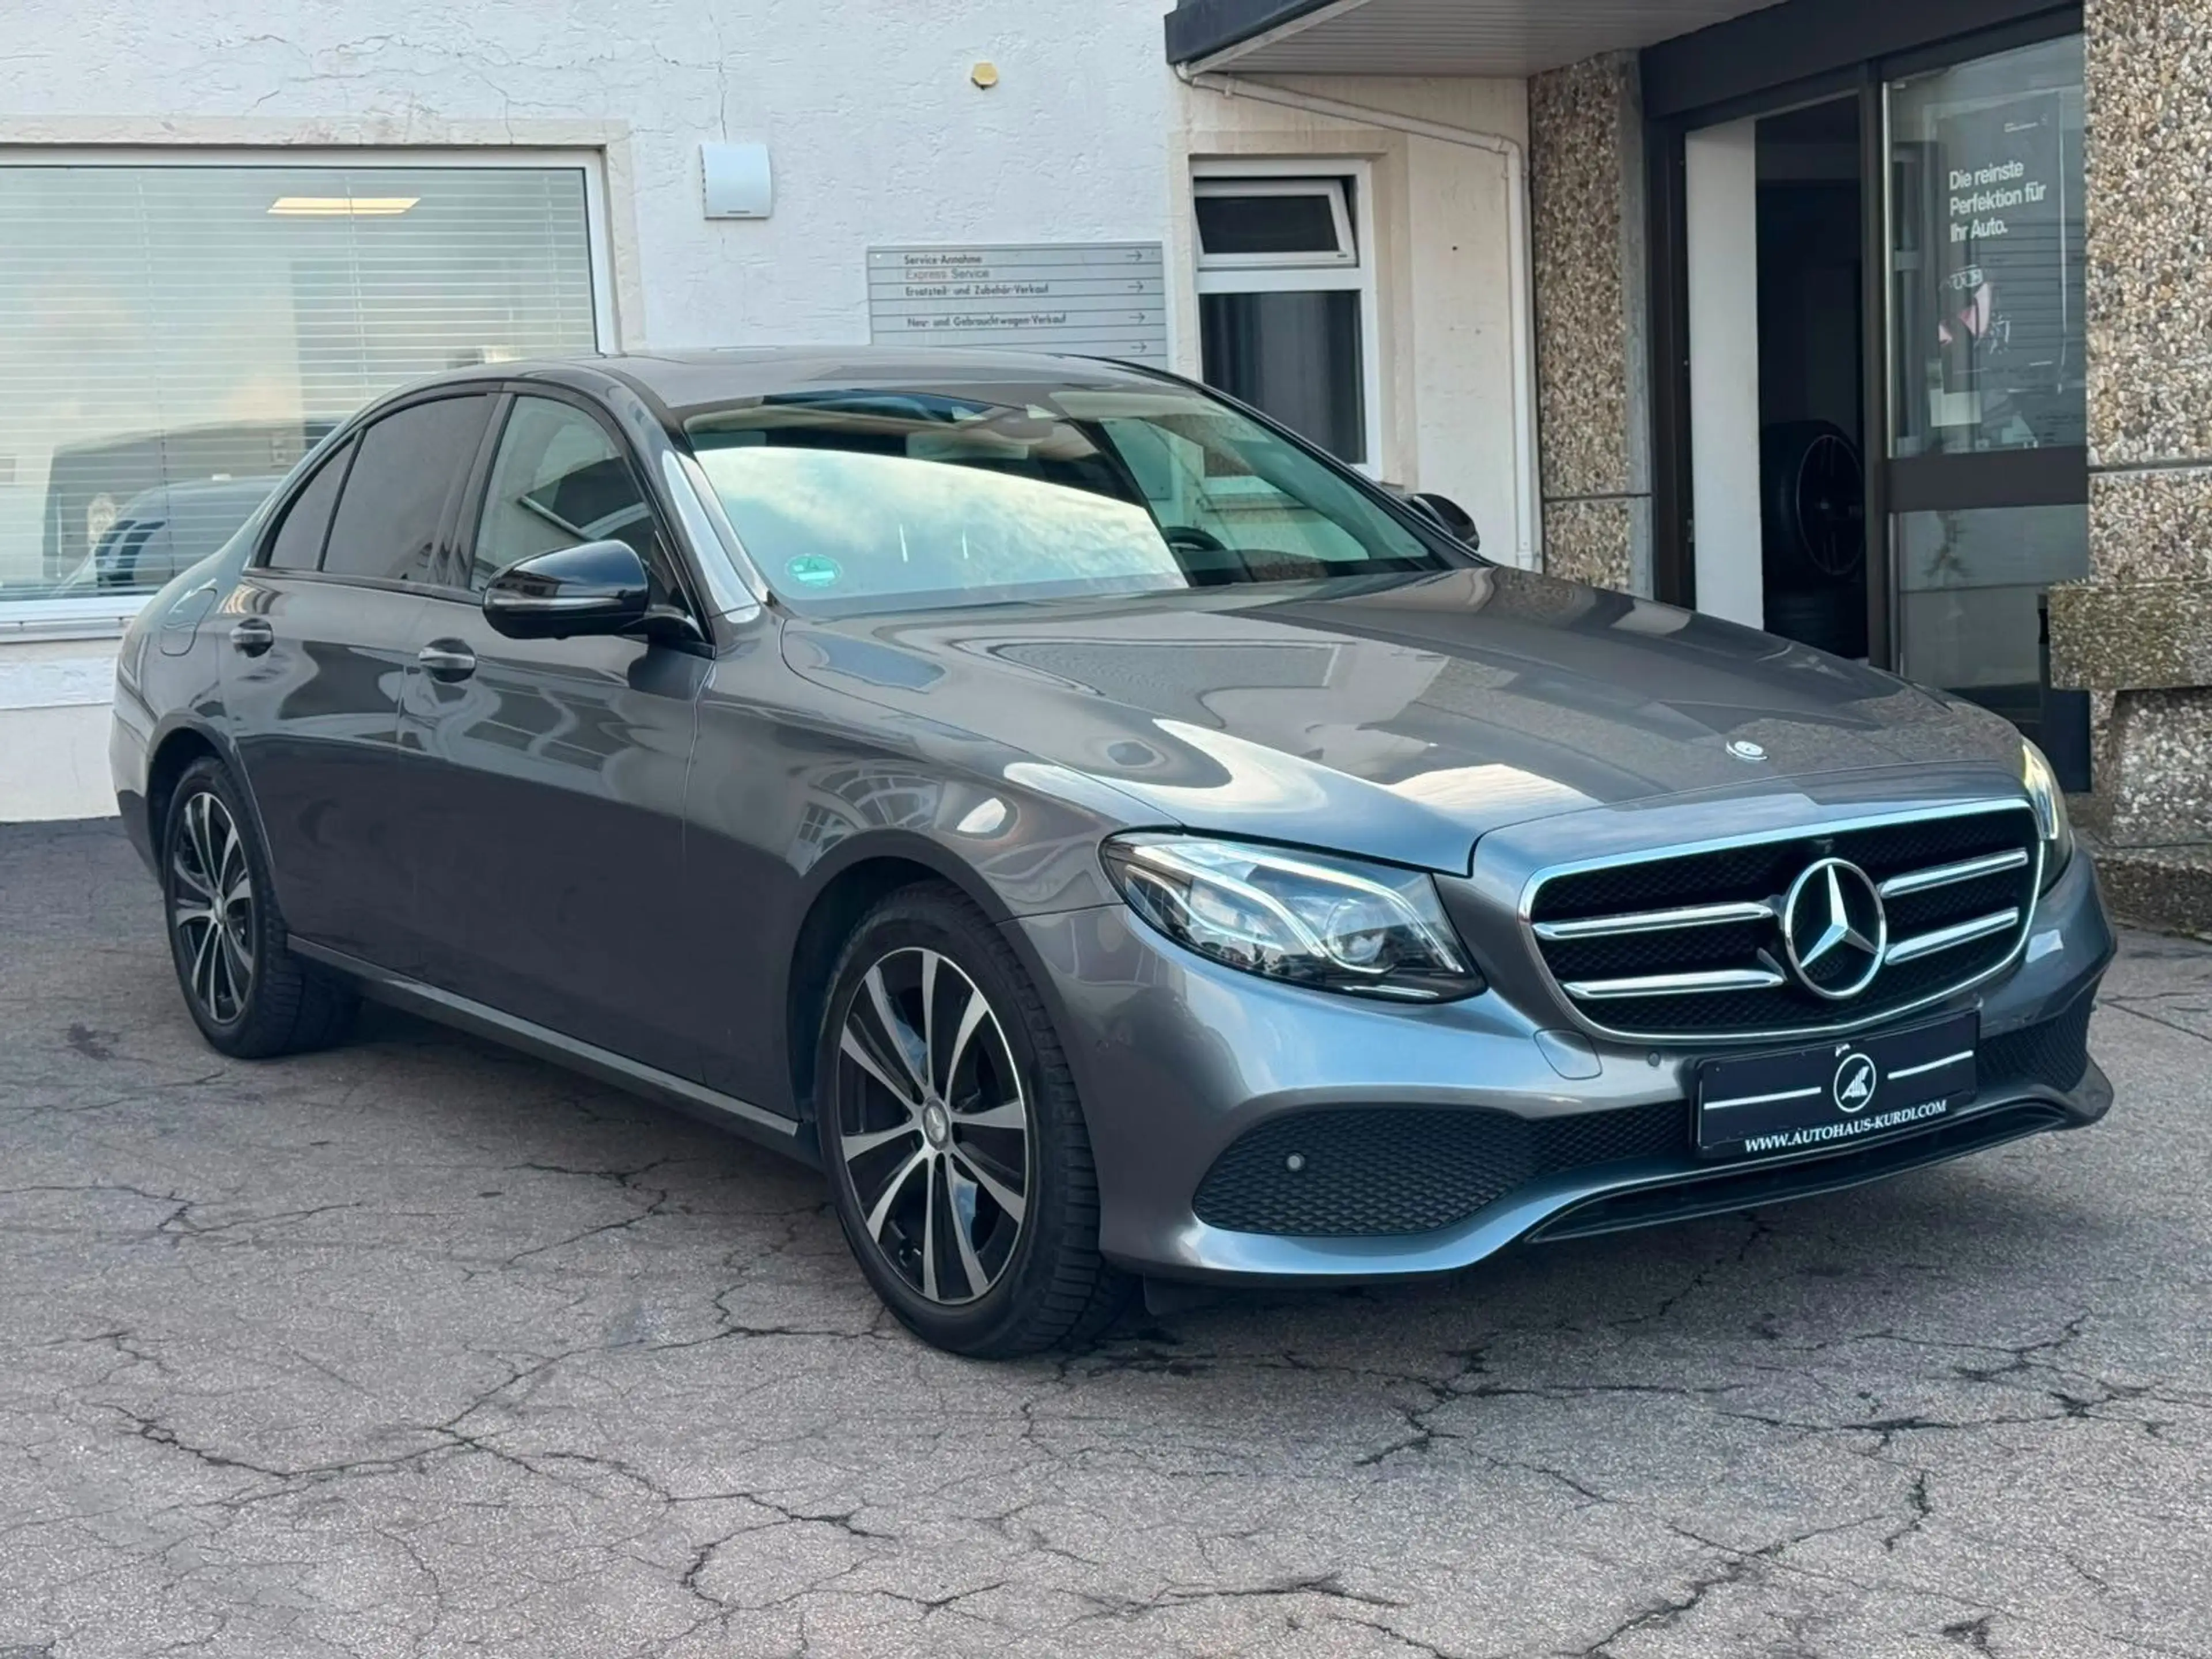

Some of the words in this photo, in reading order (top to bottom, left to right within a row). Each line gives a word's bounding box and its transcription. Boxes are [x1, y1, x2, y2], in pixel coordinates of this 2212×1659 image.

[1949, 169, 1972, 191] Die
[1975, 160, 2024, 185] reinste
[1949, 190, 2022, 217] Perfektion
[2024, 181, 2047, 202] für
[1950, 223, 1969, 243] Ihr
[1970, 217, 2008, 240] Auto.
[950, 267, 990, 279] Service
[953, 285, 970, 295] und
[933, 316, 950, 327] und
[1745, 1099, 1947, 1152] WWW.AUTOHAUS-KURDI.COM
